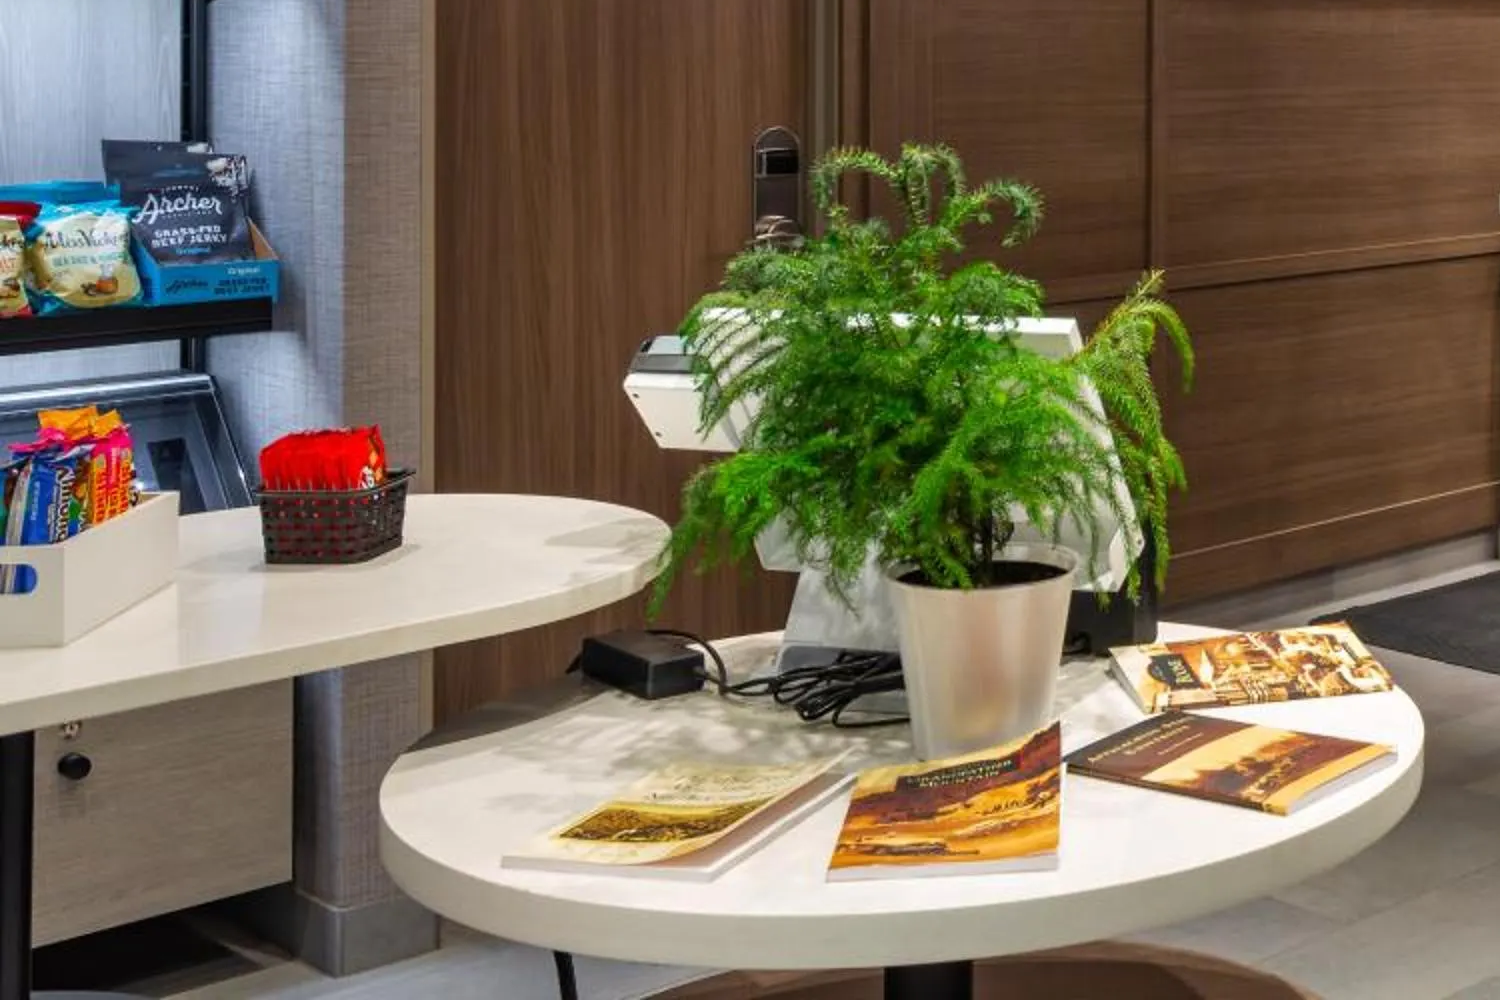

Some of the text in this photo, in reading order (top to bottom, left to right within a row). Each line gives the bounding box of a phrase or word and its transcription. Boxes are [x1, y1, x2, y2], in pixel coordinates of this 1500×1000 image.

[132, 192, 222, 225] Archer
[151, 233, 227, 249] BEEF JERKY
